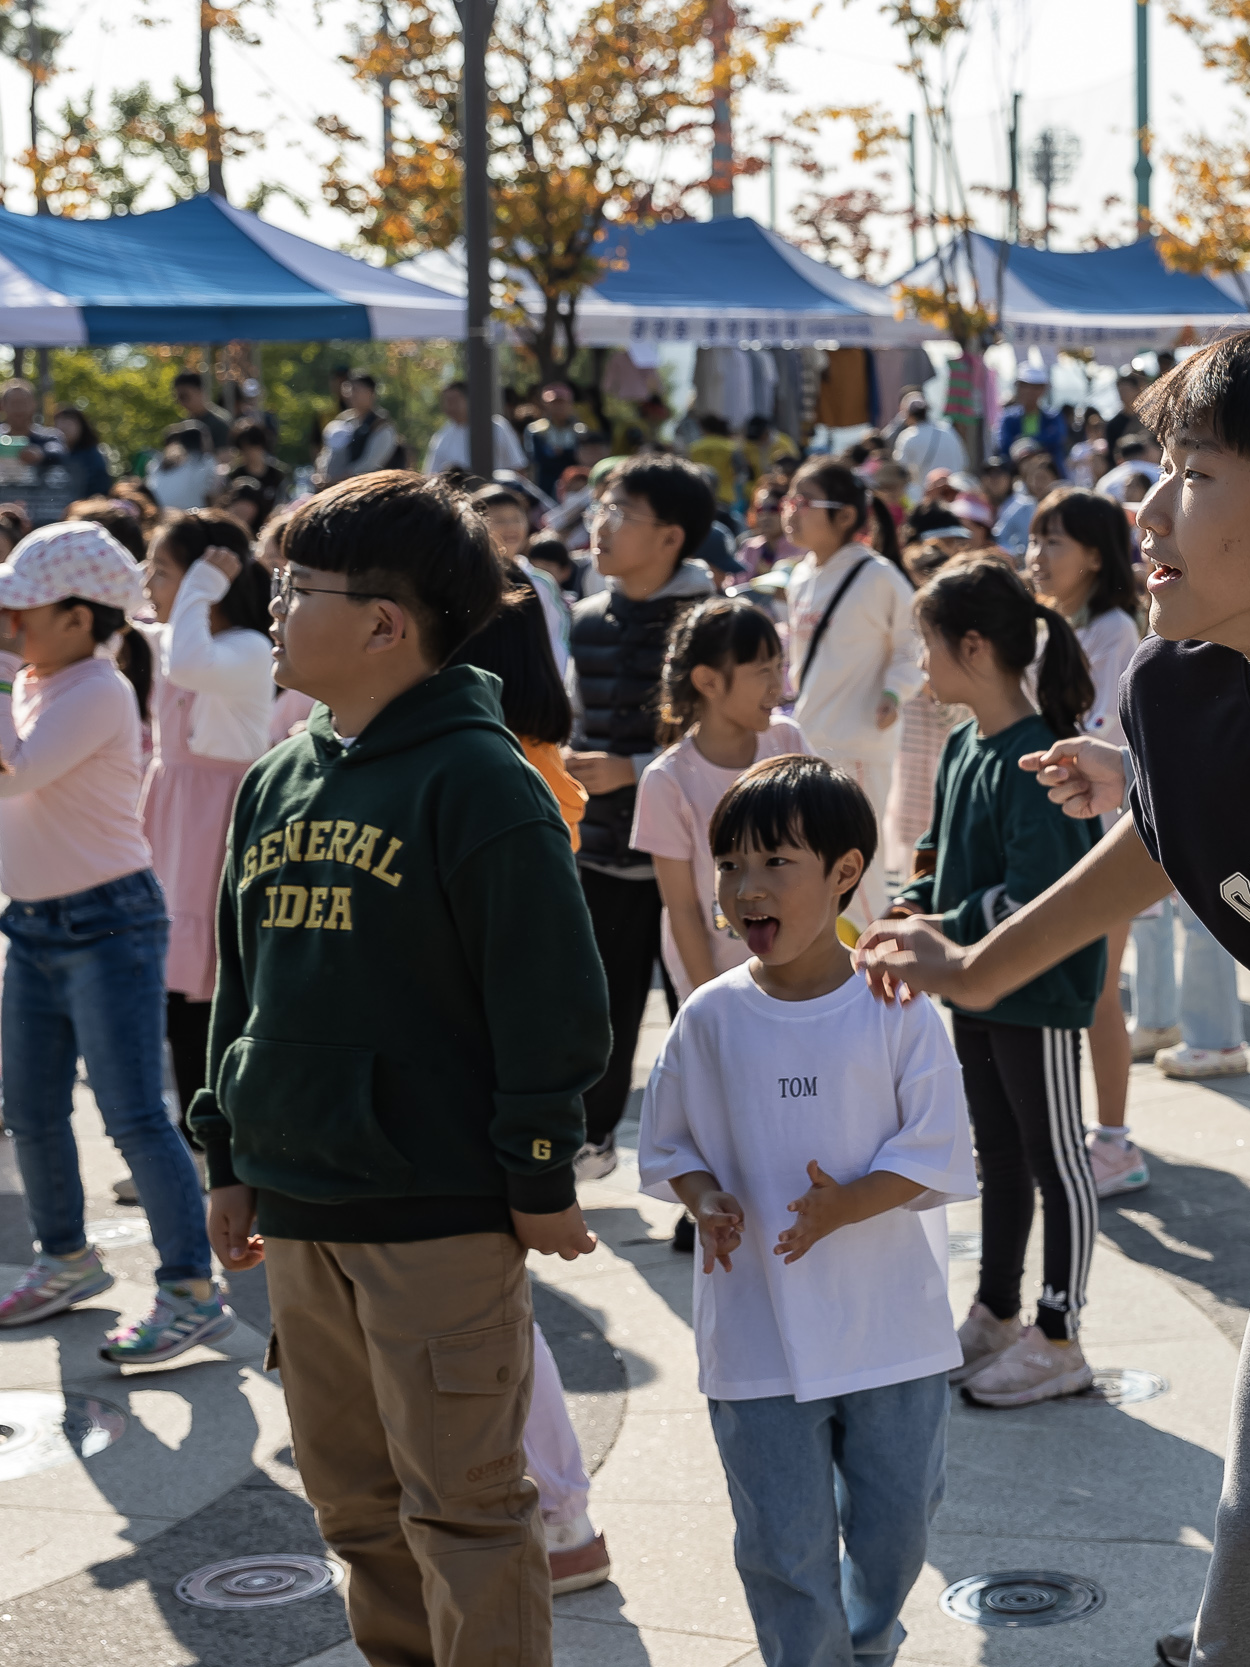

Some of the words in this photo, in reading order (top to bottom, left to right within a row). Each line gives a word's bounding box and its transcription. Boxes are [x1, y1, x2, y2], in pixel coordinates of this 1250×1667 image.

[239, 820, 403, 887] GENERAL
[261, 885, 353, 930] IDEA
[778, 1076, 818, 1099] TOM
[532, 1138, 552, 1160] G
